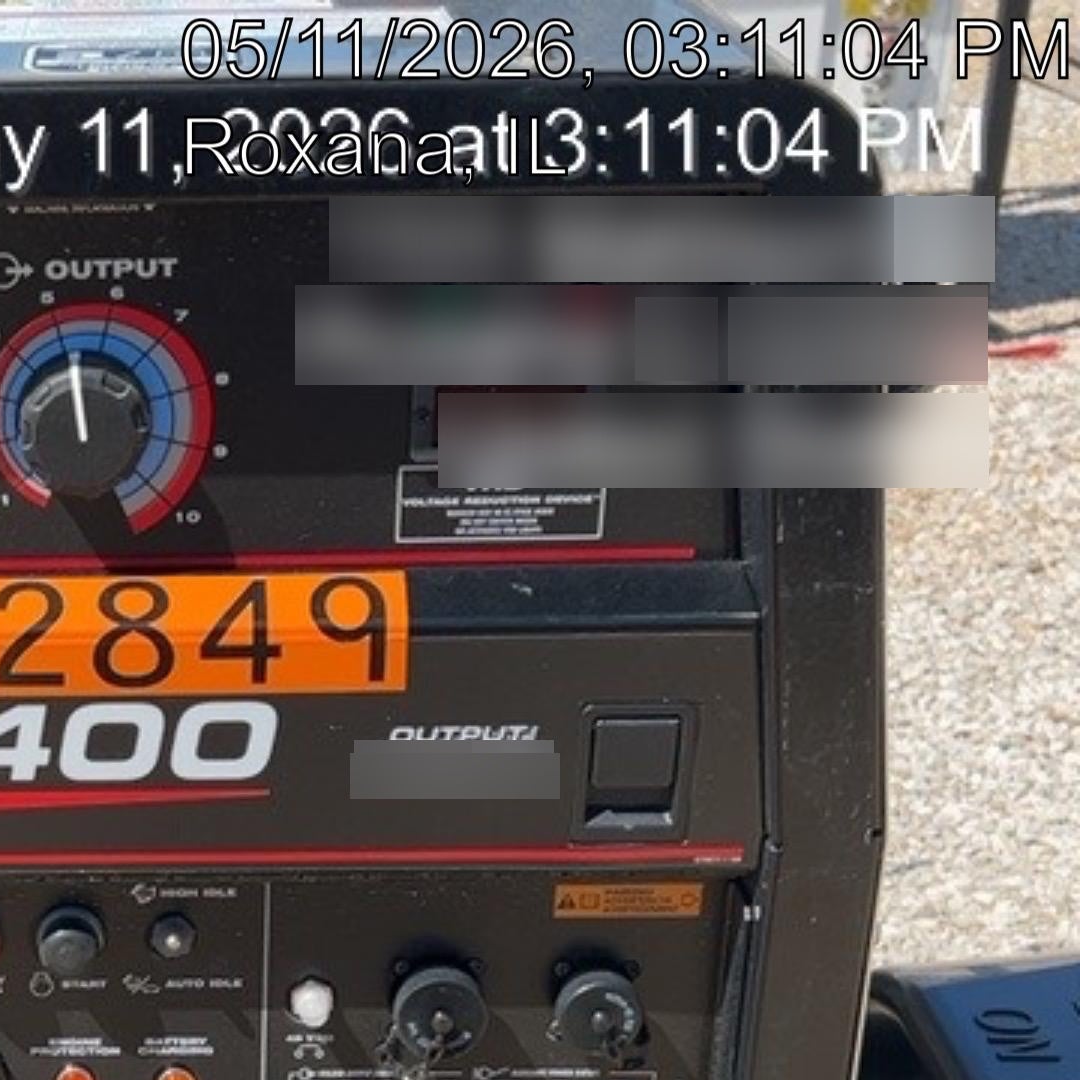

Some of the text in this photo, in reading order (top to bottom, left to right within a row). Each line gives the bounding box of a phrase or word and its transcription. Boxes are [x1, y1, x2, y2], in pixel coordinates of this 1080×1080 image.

[45, 258, 178, 281] OUTPUT
[41, 291, 55, 303] 5
[110, 286, 124, 299] 6
[174, 309, 189, 322] 7
[1, 495, 11, 507] 1
[175, 511, 202, 524] 10
[166, 978, 204, 990] AUTO
